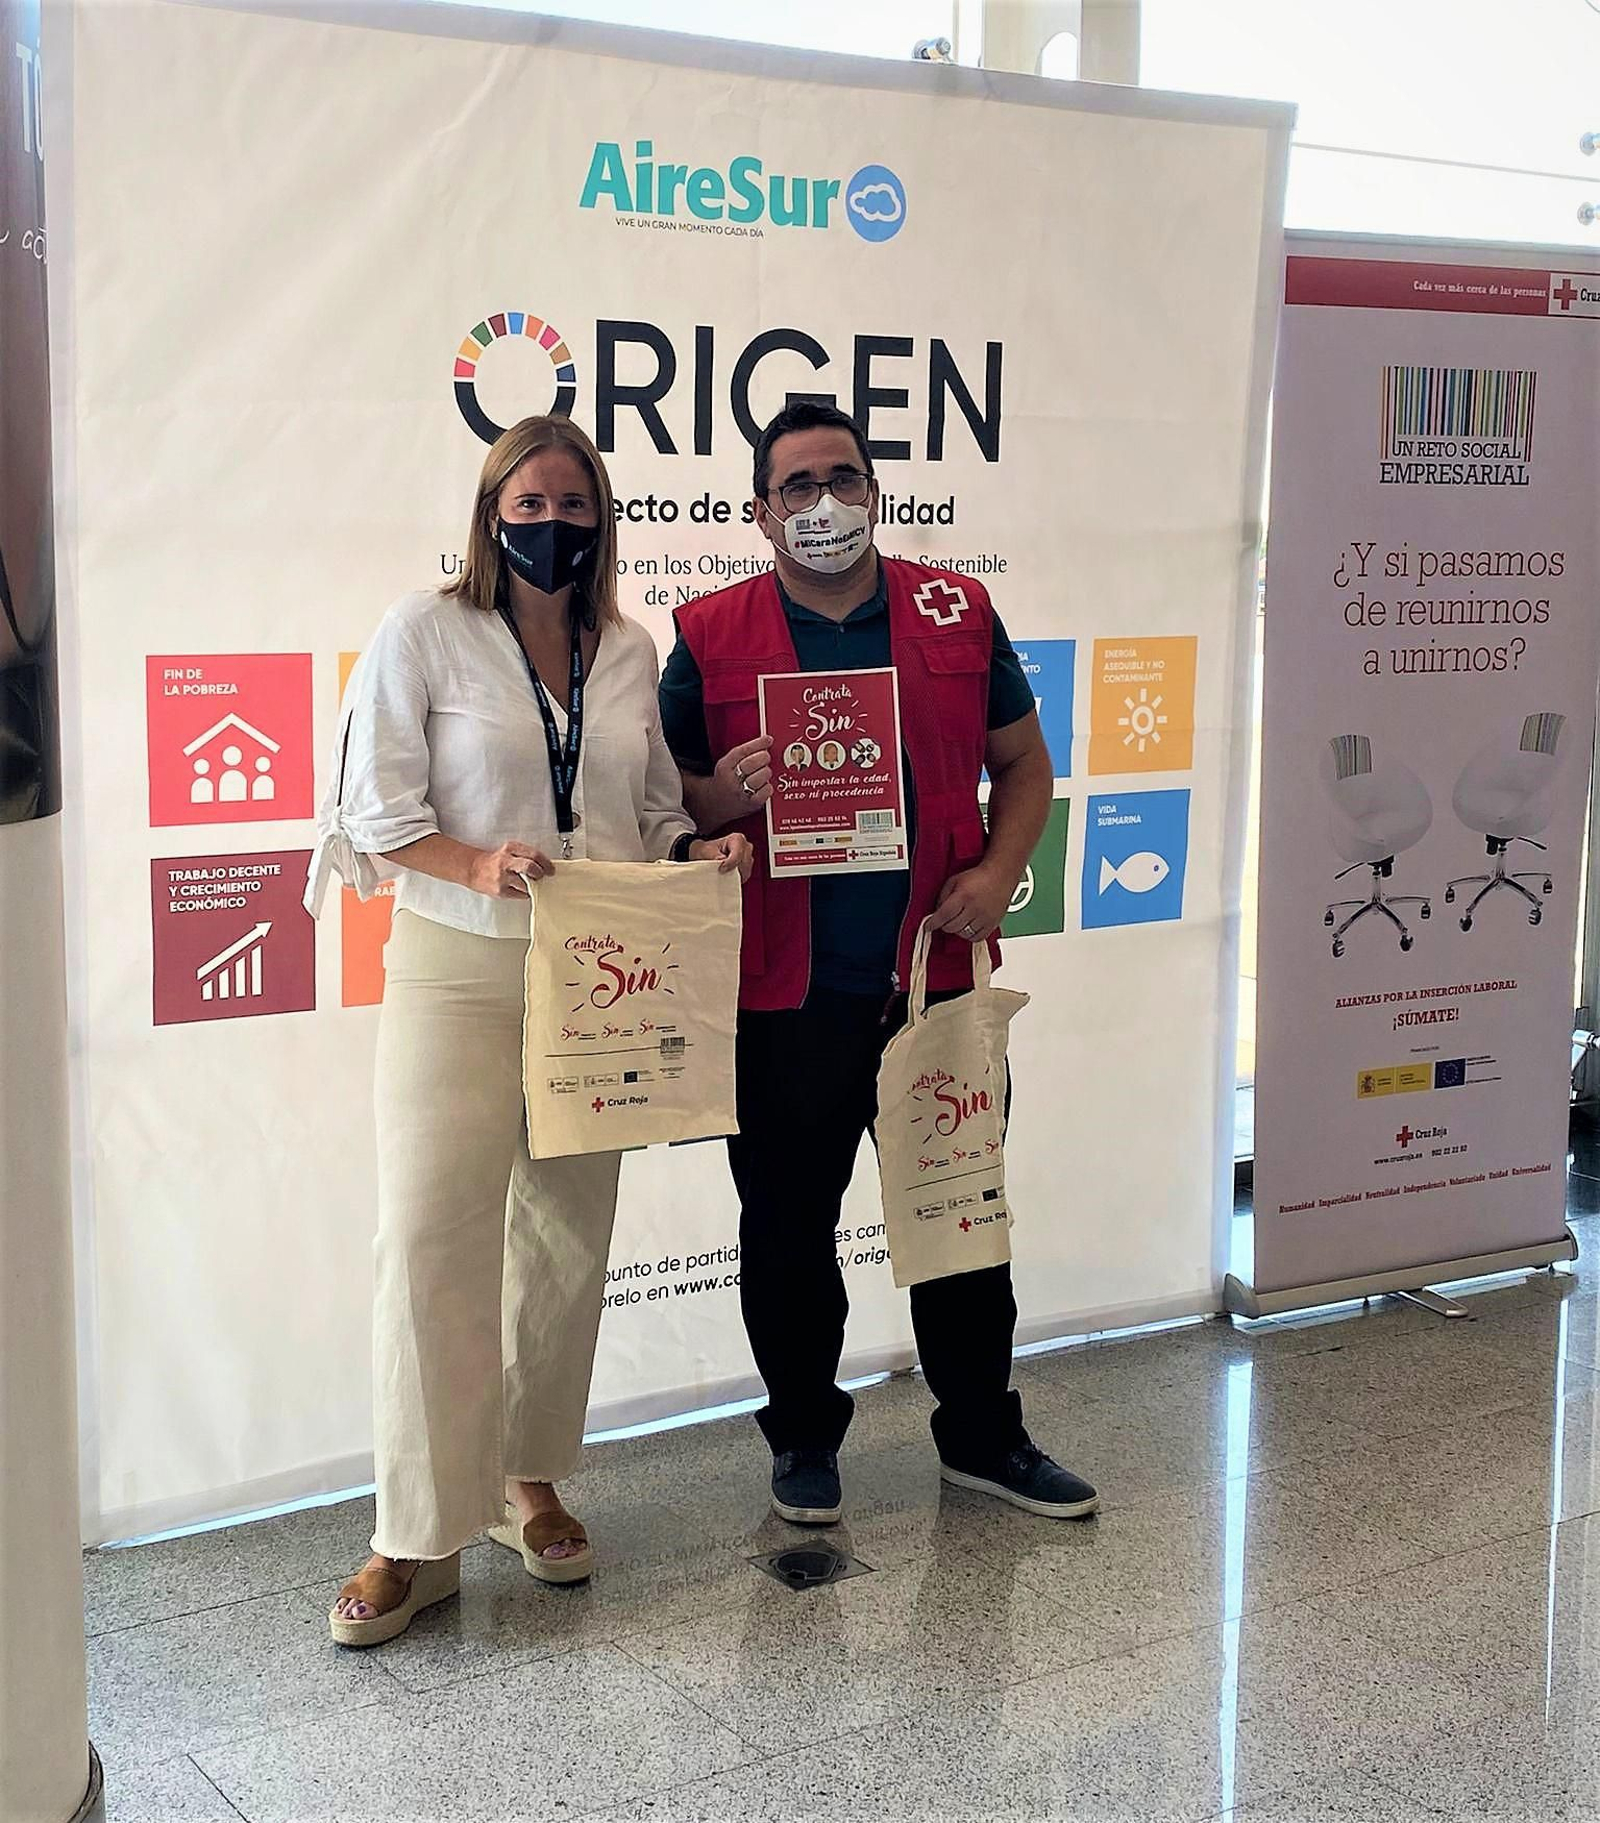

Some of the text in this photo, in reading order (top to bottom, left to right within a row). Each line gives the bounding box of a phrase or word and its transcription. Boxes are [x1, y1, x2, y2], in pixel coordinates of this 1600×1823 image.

[579, 140, 841, 228] AireSur
[615, 217, 764, 239] VIVE UN GRAN MOMENTO CADA DÍA
[1413, 280, 1547, 298] Cada vez más cerca de las personas
[453, 312, 1003, 462] ORIGEN
[1393, 440, 1521, 459] UN RETO SOCIAL
[1379, 462, 1530, 485] EMPRESARIAL
[690, 493, 733, 524] de
[634, 559, 658, 575] en
[664, 554, 692, 575] los
[1333, 541, 1565, 588] ¿Y si pasamos
[645, 585, 669, 605] de
[1344, 590, 1550, 626] de reunirnos
[1104, 647, 1137, 659] ENERGÍA
[1363, 637, 1526, 675] a unirnos?
[164, 668, 203, 680] FIN DE
[1103, 660, 1165, 671] ASEQUIBLE Y NO
[1103, 672, 1163, 683] CONTAMINANTE
[164, 683, 239, 695] LA POBREZA
[803, 683, 852, 704] Contrata
[805, 702, 856, 742] Sin
[777, 772, 799, 793] Sin
[801, 777, 846, 791] importar
[849, 774, 859, 784] la
[784, 786, 884, 800] sexo ni procedencia
[1098, 804, 1117, 814] VIDA
[1098, 815, 1142, 827] SUBMARINA
[168, 864, 281, 882] TRABAJO DECENTE
[169, 881, 261, 897] Y CRECIMIENTO
[169, 895, 246, 912] ECONÓMICO
[564, 934, 618, 952] Contrata
[590, 945, 661, 1009] Sin
[1335, 980, 1517, 1009] ALIANZAS POR LA INSERCIÓN LABORAL
[1392, 1007, 1459, 1031] ¡SÚMATE!
[560, 1024, 579, 1041] Sin
[601, 1021, 619, 1039] Sin
[607, 1095, 648, 1107] Cruz Roja
[934, 1075, 993, 1136] Sin
[1415, 1129, 1431, 1140] Cruz
[1319, 1193, 1362, 1207] Imparcialidad
[973, 1215, 994, 1226] Cruz
[657, 1256, 680, 1276] de
[647, 1285, 669, 1300] en
